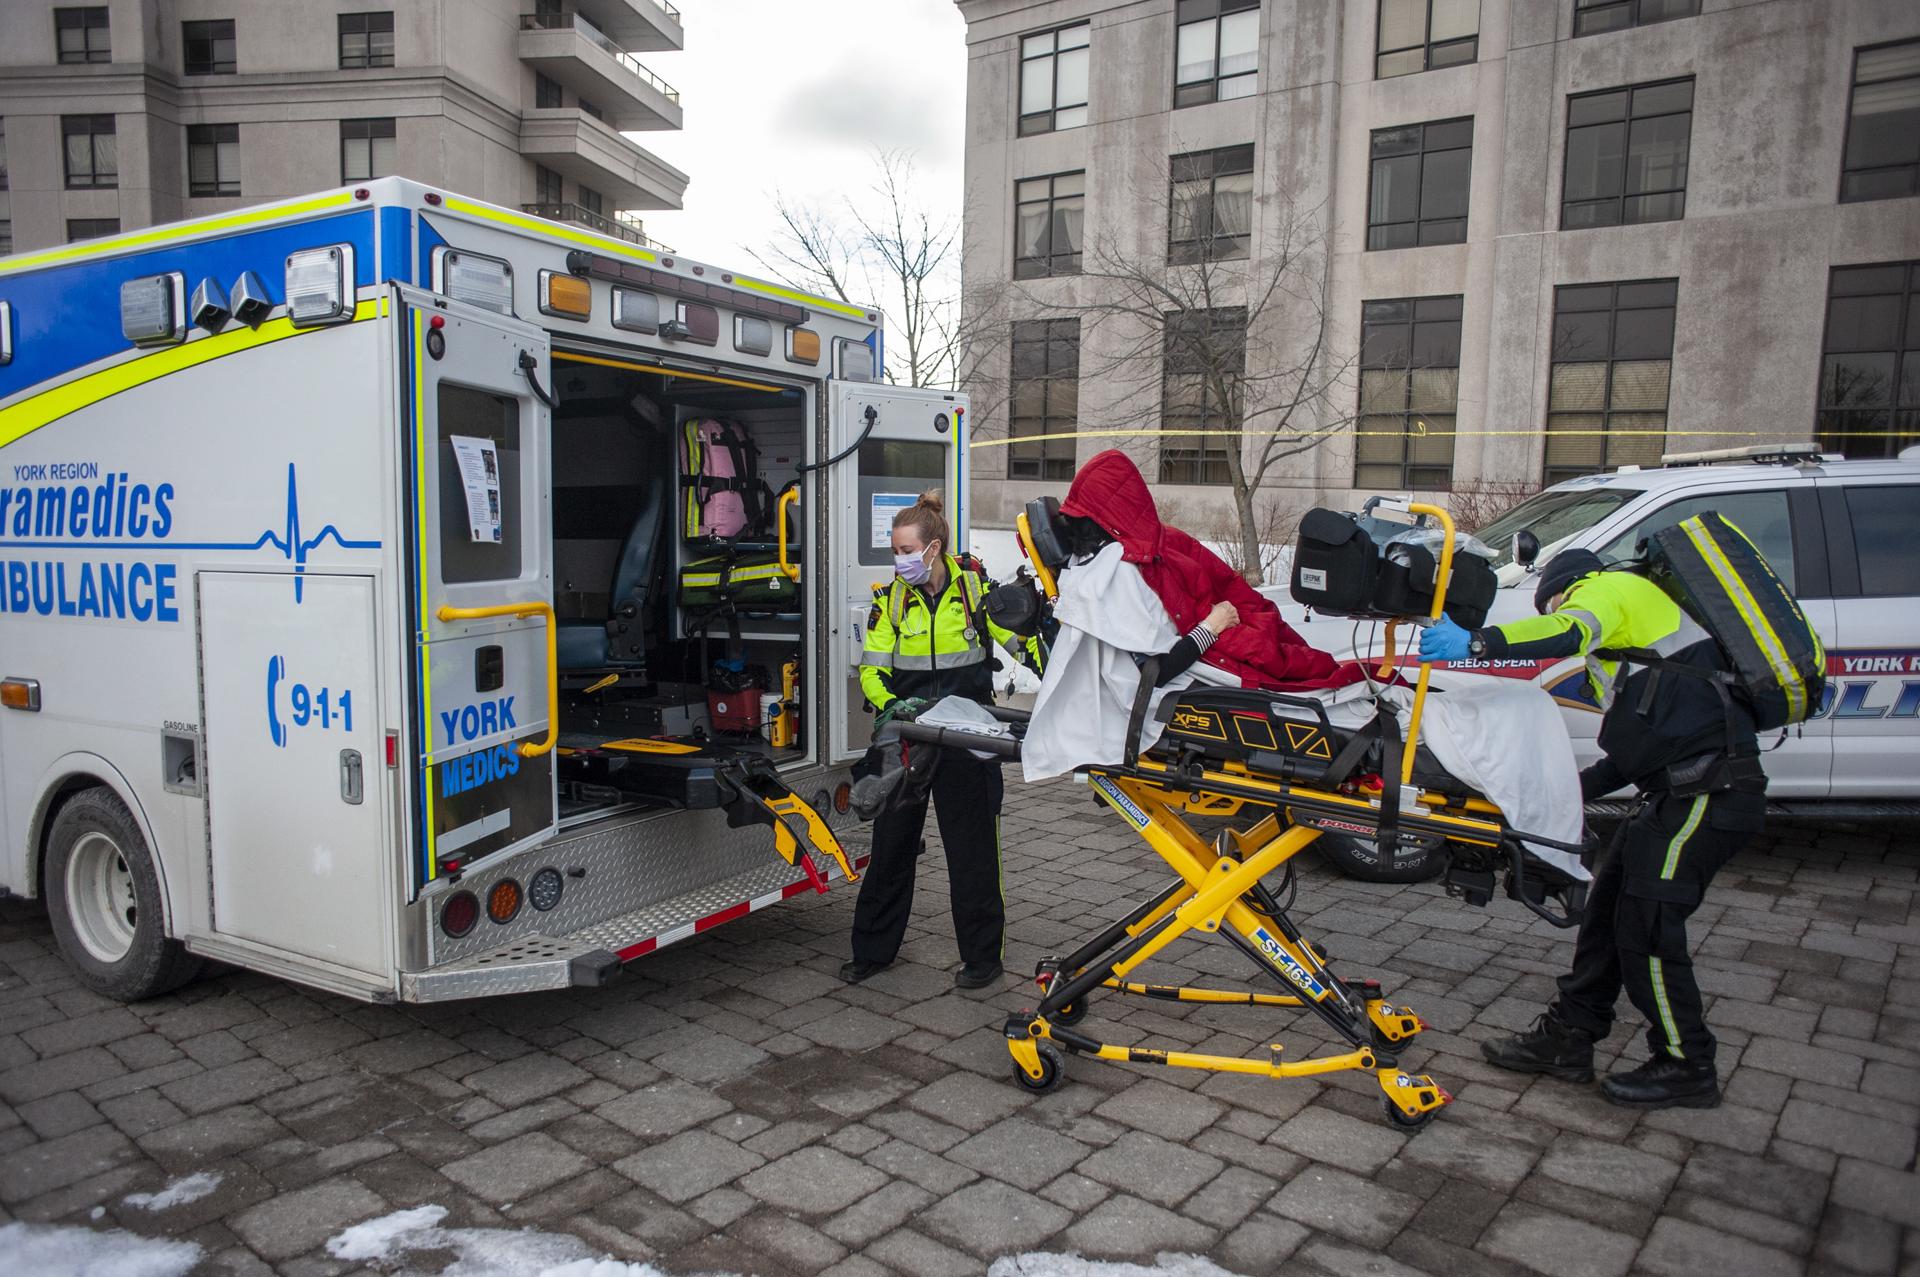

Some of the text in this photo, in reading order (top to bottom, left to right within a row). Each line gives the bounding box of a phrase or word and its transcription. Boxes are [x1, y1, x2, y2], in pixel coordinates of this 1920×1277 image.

[14, 462, 98, 481] YORK REGION
[1448, 658, 1536, 669] DEEDS SPEAK
[1843, 657, 1905, 672] YORK
[292, 683, 353, 732] 9-1-1
[1173, 712, 1210, 728] XPS
[163, 720, 198, 733] GASOLINE
[440, 696, 516, 746] YORK
[442, 741, 520, 798] MEDICS
[1115, 793, 1148, 825] PARAMEDICS
[1261, 939, 1312, 989] ST-163
